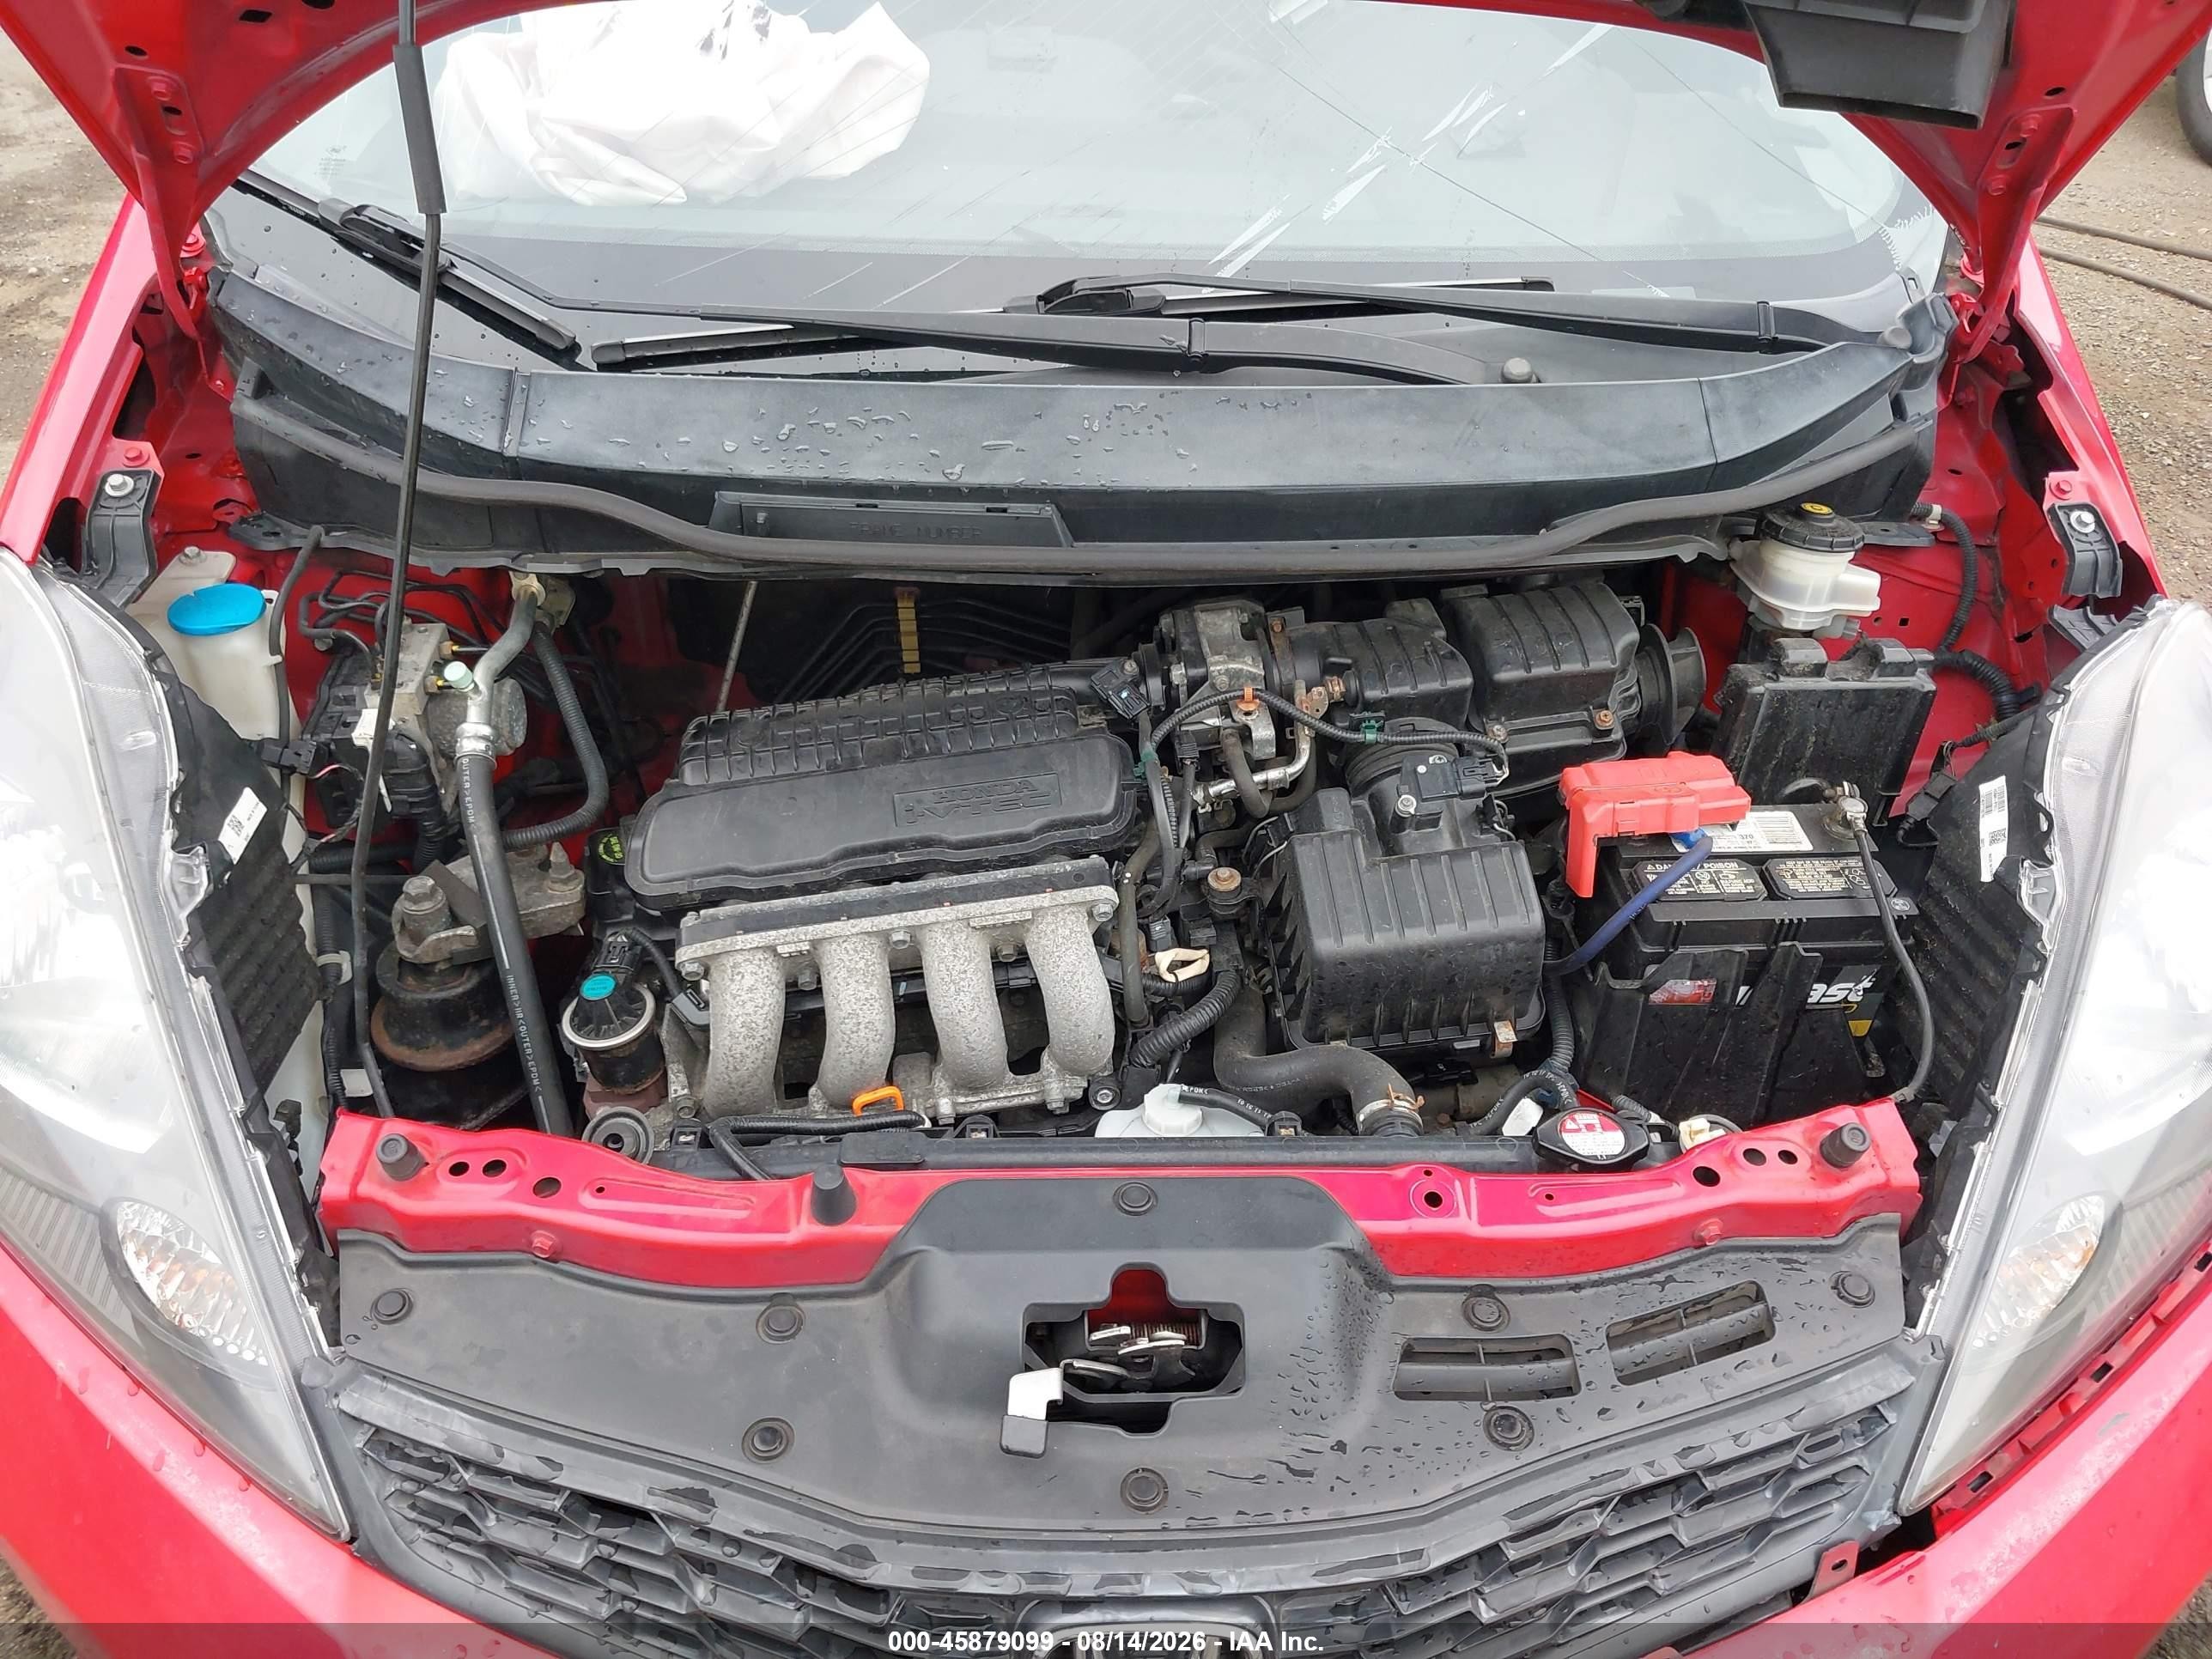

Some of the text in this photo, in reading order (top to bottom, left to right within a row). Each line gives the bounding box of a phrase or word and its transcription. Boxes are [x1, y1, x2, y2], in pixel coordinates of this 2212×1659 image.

[849, 520, 983, 539] FRAME NUMBER
[933, 780, 1039, 804] HONDA
[1703, 861, 1739, 870] POISON
